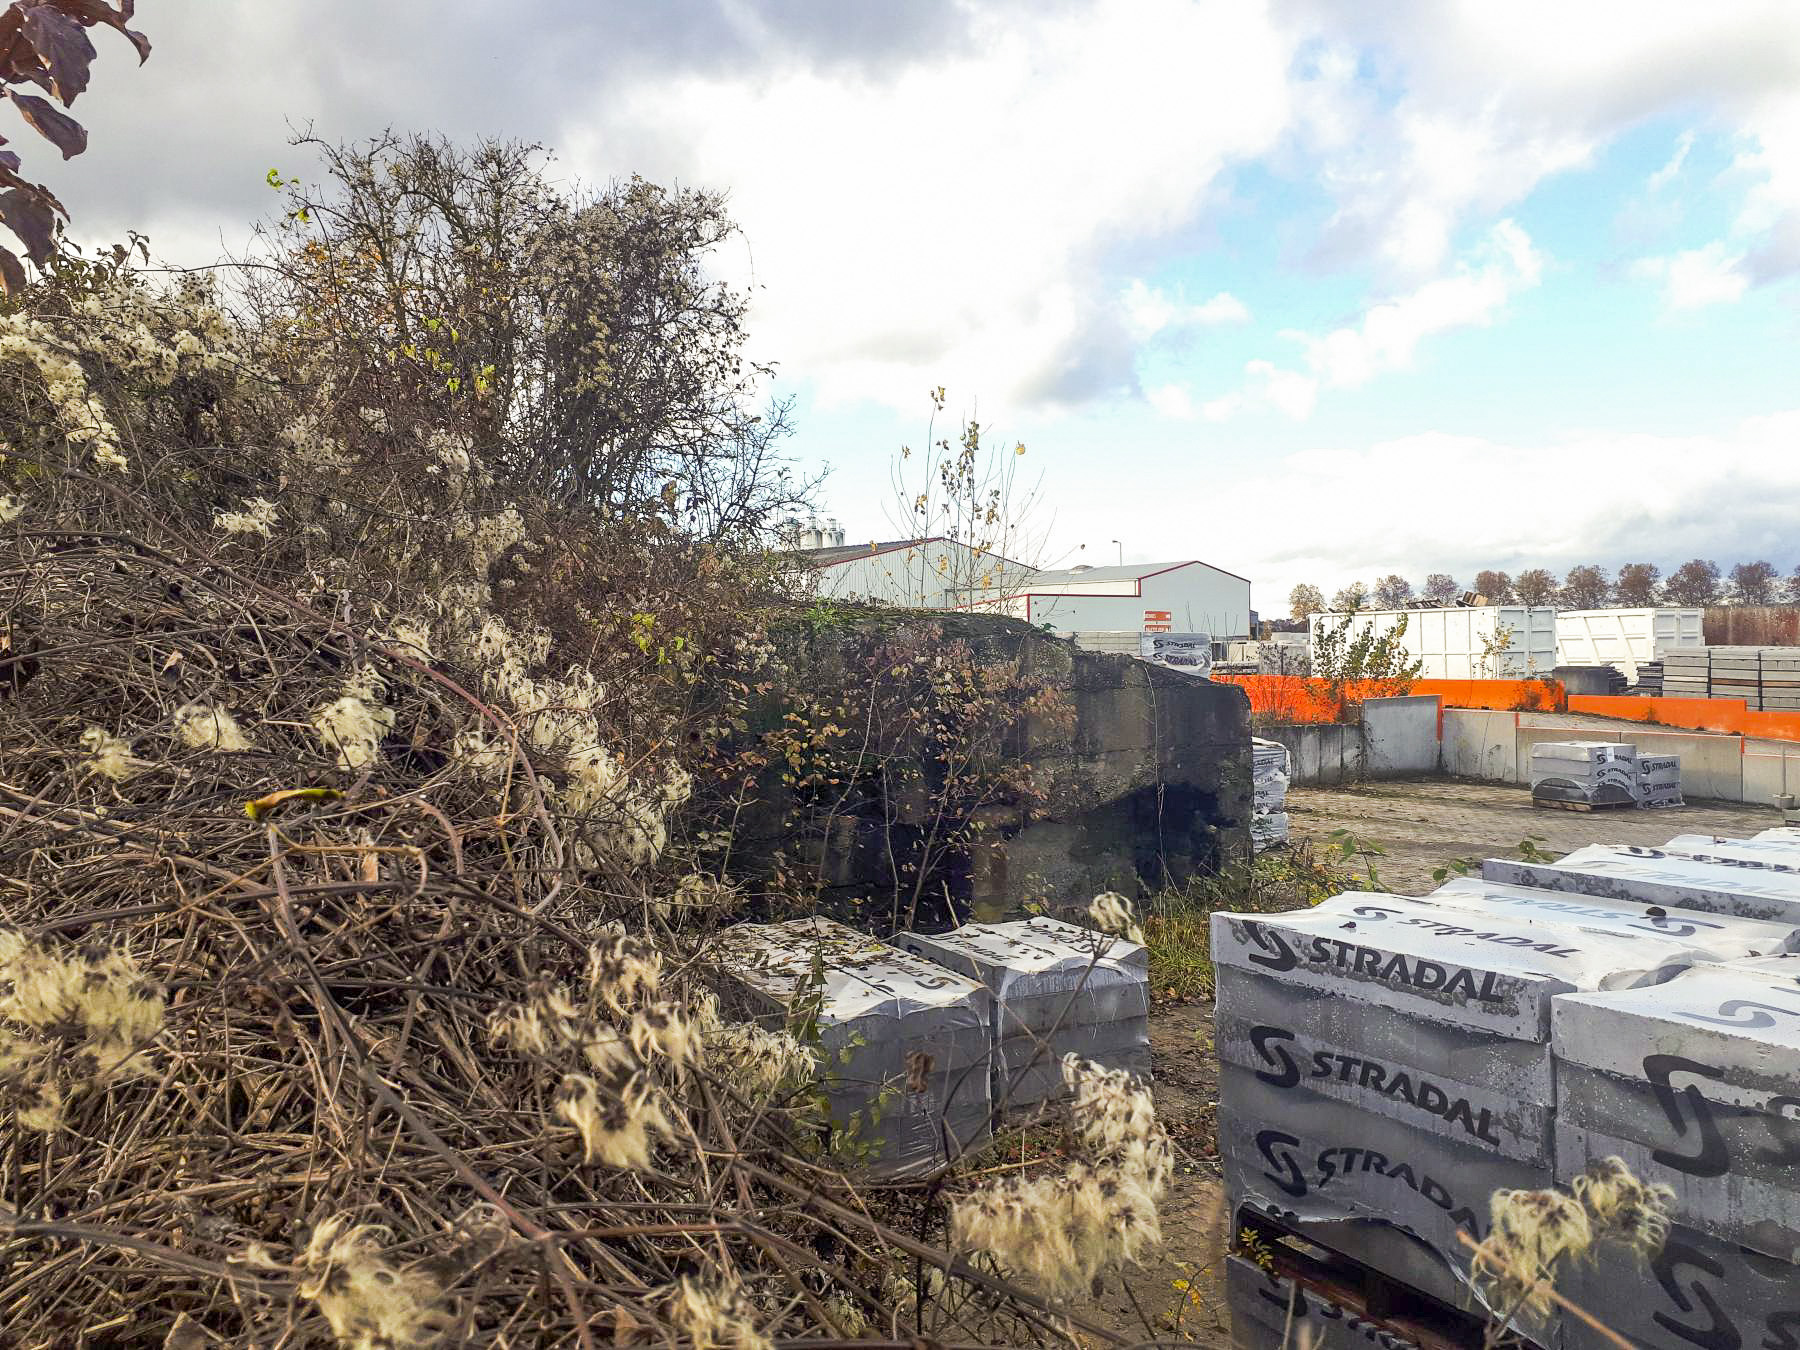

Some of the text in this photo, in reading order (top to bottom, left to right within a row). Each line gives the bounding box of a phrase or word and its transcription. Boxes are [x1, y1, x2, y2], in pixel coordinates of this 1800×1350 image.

[1307, 936, 1502, 1001] STRADAL
[1399, 918, 1582, 958] STRADAL
[1310, 1051, 1501, 1147] STRADAL
[1316, 1147, 1490, 1244] STRADA
